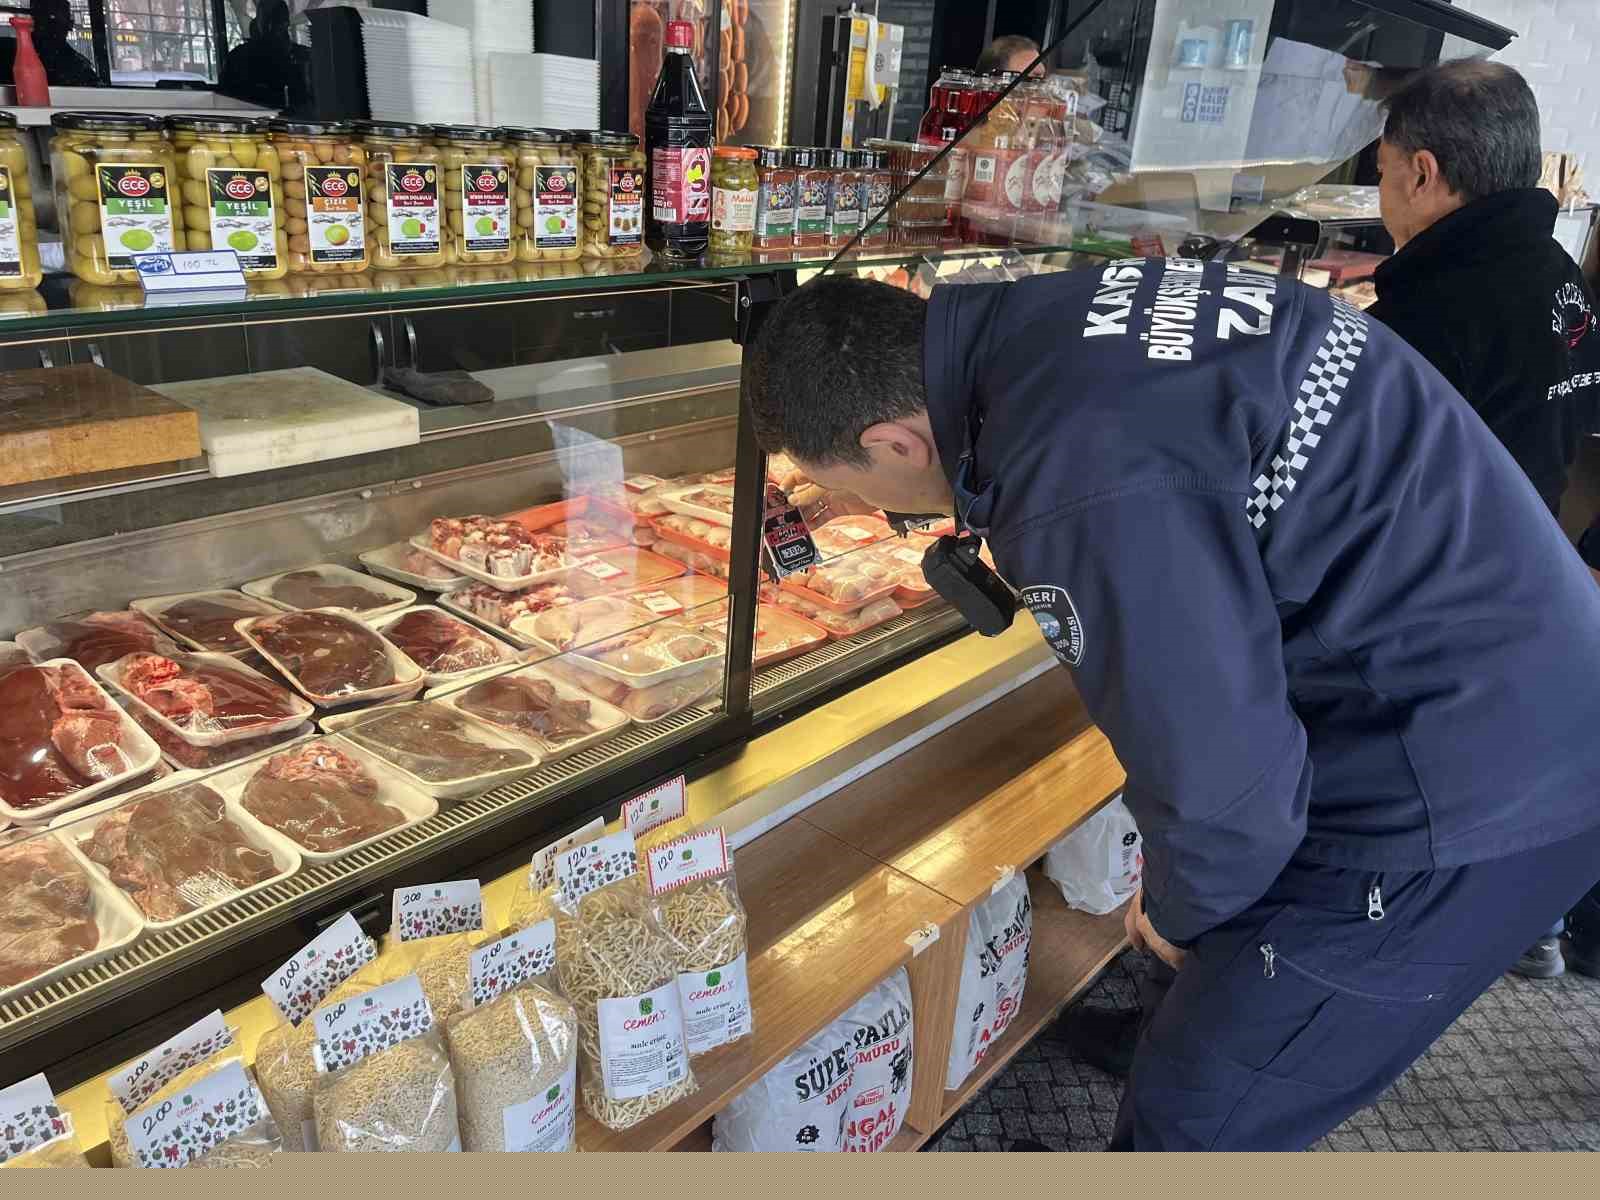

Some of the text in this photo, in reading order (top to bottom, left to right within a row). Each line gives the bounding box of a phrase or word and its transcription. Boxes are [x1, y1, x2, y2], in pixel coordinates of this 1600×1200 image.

[122, 181, 145, 191] ECE
[229, 184, 252, 194] ECE
[325, 183, 345, 191] ECE
[404, 179, 422, 187] ECE
[118, 199, 154, 209] YEŞİL
[226, 202, 258, 211] YEŞİL
[568, 846, 587, 872] 120
[657, 850, 674, 872] 120
[403, 891, 421, 906] 200
[481, 943, 502, 968] 200
[280, 960, 300, 989] 200
[325, 1003, 346, 1027] 200
[127, 1060, 149, 1085] 200
[142, 1101, 173, 1136] 200
